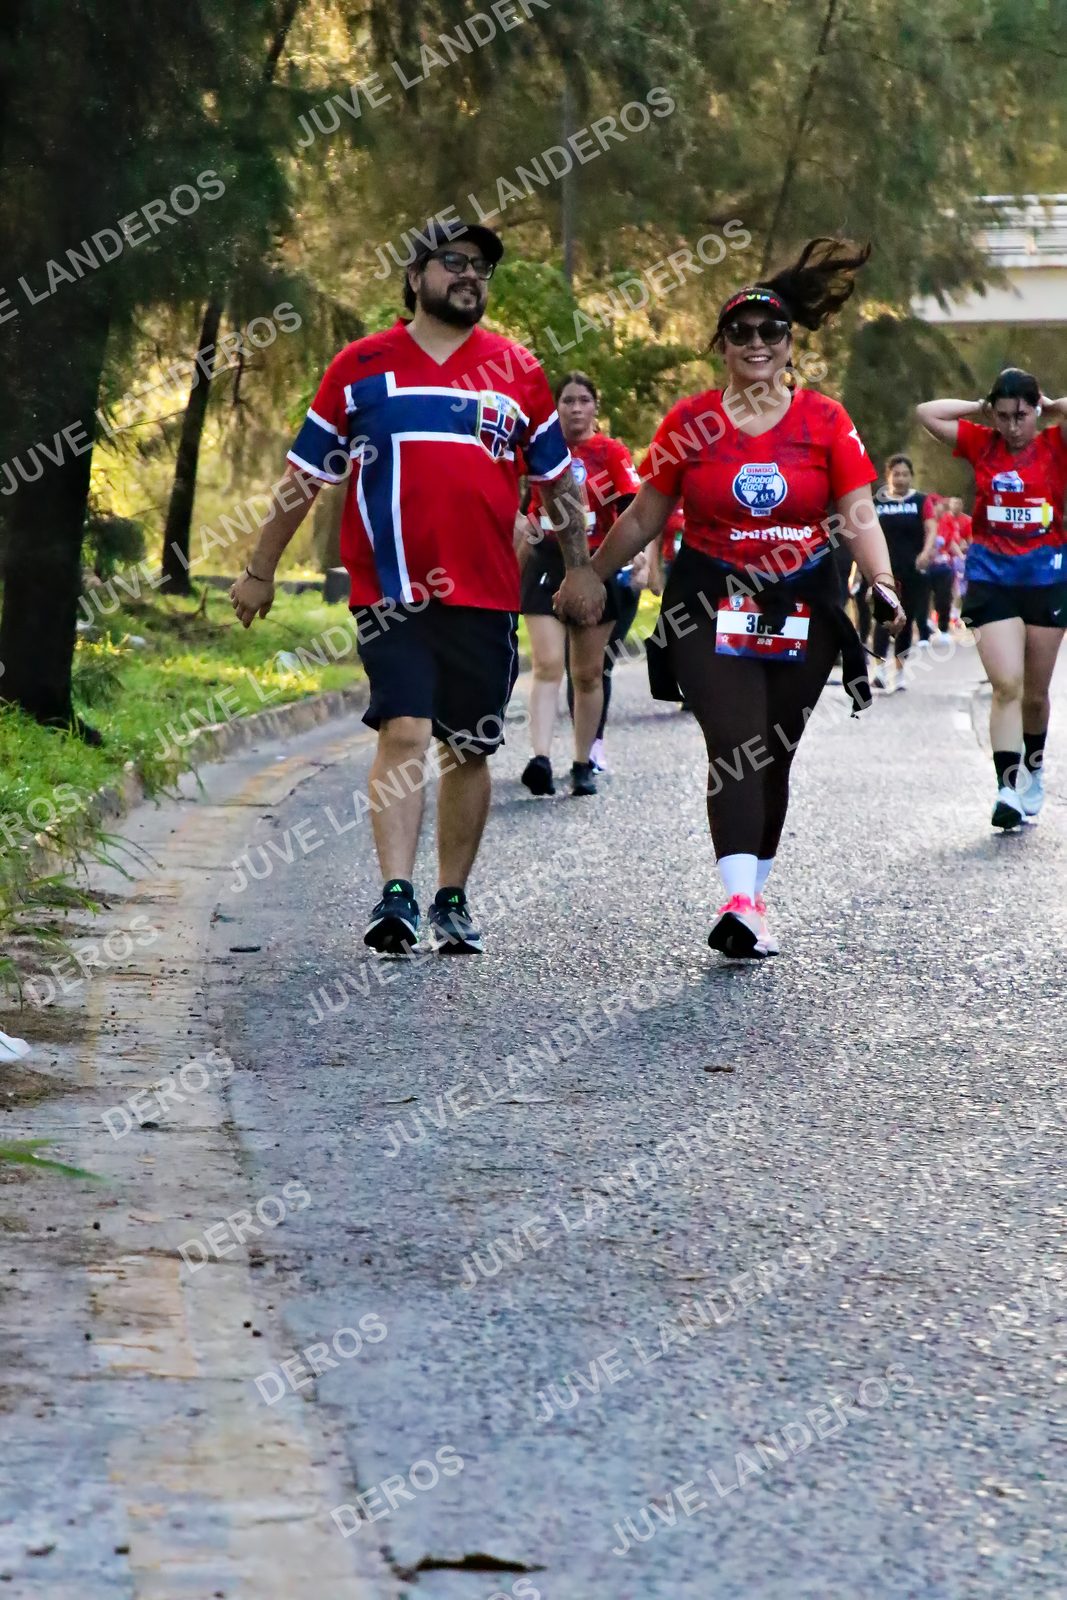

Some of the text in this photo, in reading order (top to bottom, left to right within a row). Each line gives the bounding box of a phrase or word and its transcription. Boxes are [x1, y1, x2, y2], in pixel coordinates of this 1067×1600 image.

[746, 476, 774, 484] Global
[741, 483, 763, 491] Race
[876, 503, 918, 514] CANADA
[1005, 508, 1031, 521] 3125
